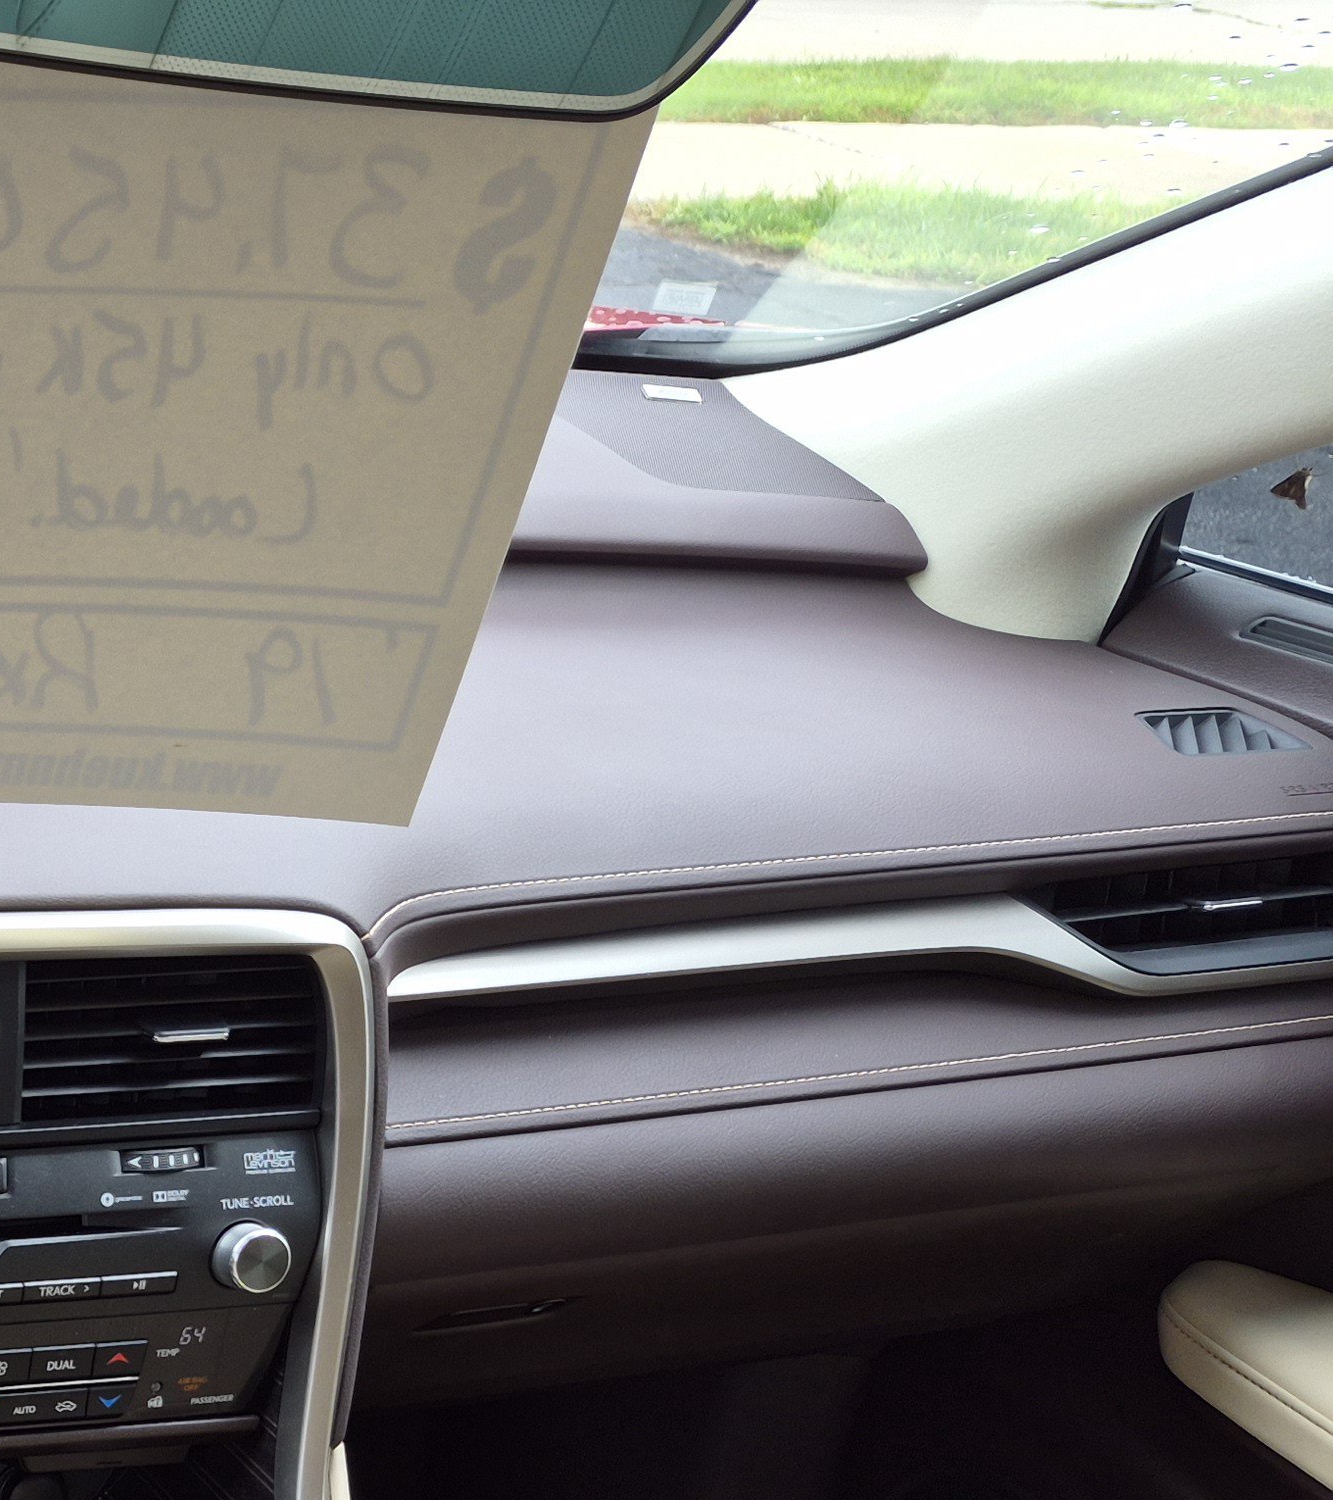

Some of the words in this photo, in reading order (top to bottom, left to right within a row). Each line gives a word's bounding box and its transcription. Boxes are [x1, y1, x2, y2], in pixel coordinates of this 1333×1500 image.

[39, 1285, 75, 1297] TRACK
[156, 1347, 180, 1358] TEMP
[46, 1359, 76, 1372] DUAL
[13, 1405, 36, 1415] AUTO
